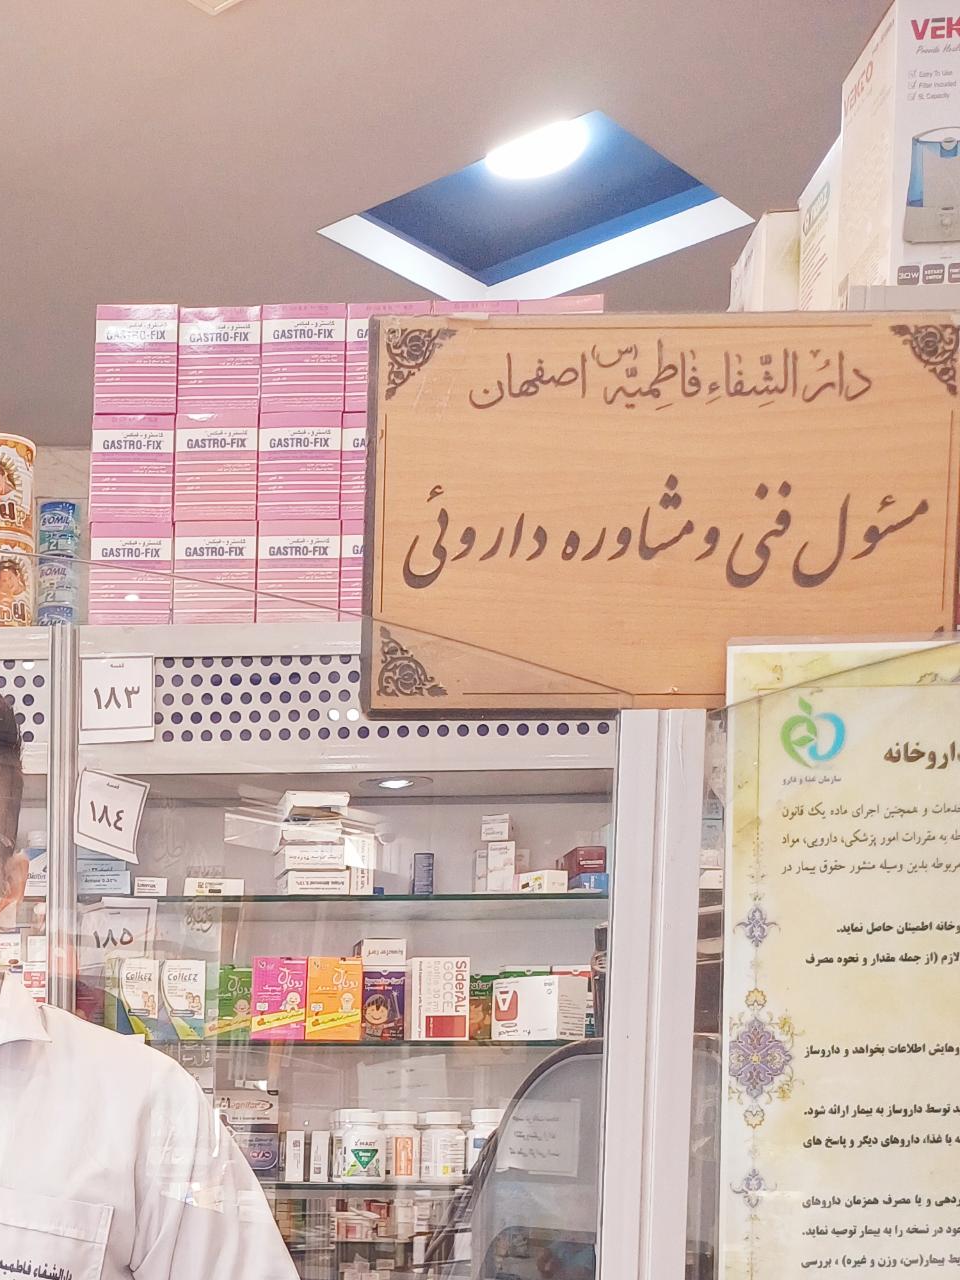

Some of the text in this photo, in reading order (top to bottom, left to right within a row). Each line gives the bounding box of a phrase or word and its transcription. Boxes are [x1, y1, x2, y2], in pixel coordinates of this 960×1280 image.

[272, 328, 333, 341] GASTRO-FIX
[469, 352, 587, 410] اصفهان
[102, 439, 162, 451] GASTRO-FIX
[186, 437, 247, 450] GASTRO-FIX
[269, 436, 330, 449] GASTRO-FIX
[560, 474, 695, 562] مشاوره
[726, 480, 791, 589] فنی
[184, 545, 244, 557] GASTRO-FIX
[268, 545, 330, 557] GASTRO-FIX
[695, 526, 721, 562] و
[101, 546, 161, 558] GASTRO-FIX
[93, 685, 141, 710] ۱۸۳
[852, 803, 880, 820] اجرای
[781, 832, 800, 848] مواد
[795, 859, 816, 875] بیمار
[866, 921, 894, 936] حاصل
[896, 920, 933, 936] اطمینان
[805, 952, 834, 967] مصرف
[869, 952, 896, 967] مقدار
[899, 953, 921, 966] جمله
[804, 1044, 841, 1059] داروساز
[851, 1043, 885, 1058] بخواهد
[851, 1104, 874, 1118] بیمار
[885, 1103, 923, 1118] داروساز
